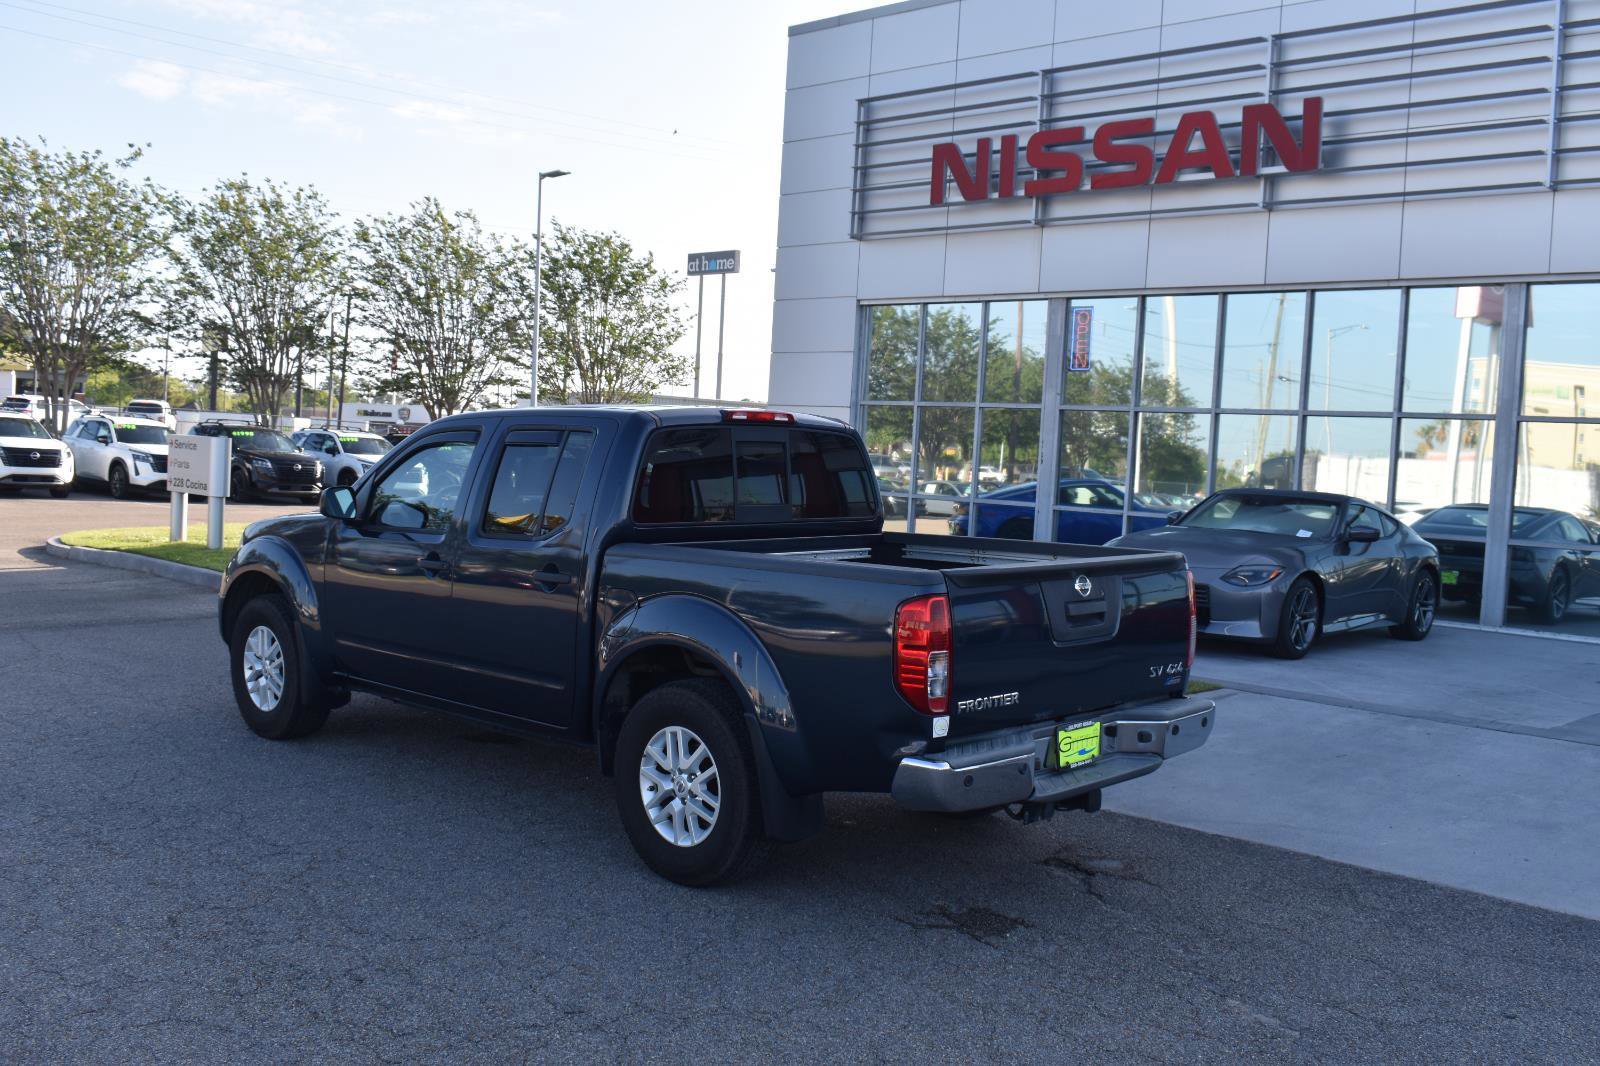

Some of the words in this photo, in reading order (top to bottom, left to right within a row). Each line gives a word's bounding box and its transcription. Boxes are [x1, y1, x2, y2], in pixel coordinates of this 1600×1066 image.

[930, 96, 1323, 206] NISSAN
[688, 258, 700, 272] at
[1075, 311, 1091, 368] OPEN
[174, 439, 197, 450] Service
[173, 458, 190, 469] Parts
[173, 477, 184, 488] 228
[185, 478, 208, 491] Cocina
[1149, 665, 1163, 678] SV
[957, 691, 1020, 713] FRONTIER
